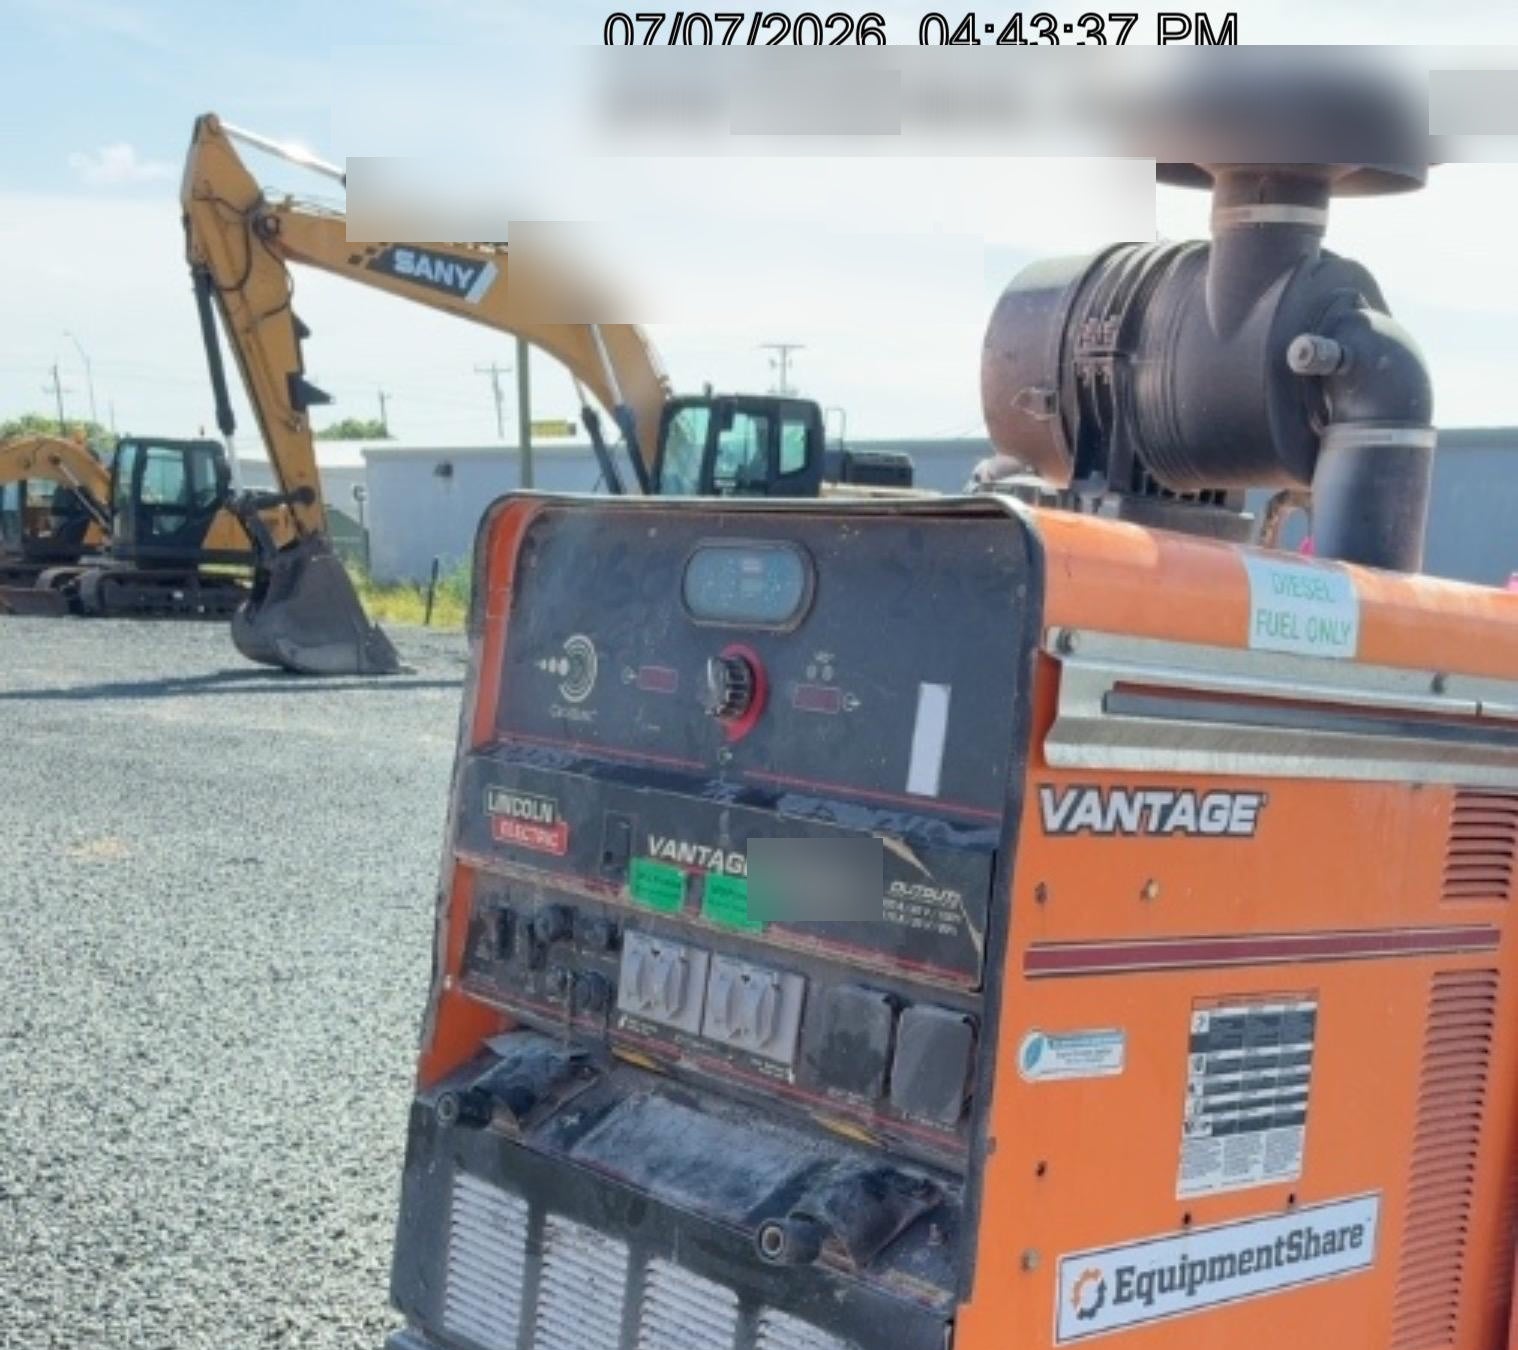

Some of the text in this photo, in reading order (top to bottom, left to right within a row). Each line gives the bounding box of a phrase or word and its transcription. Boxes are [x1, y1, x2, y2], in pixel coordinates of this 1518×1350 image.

[393, 248, 474, 289] SANY
[1272, 571, 1336, 604] DIESEL
[1256, 607, 1351, 646] FUEL ONLY
[487, 790, 554, 824] LINCOLN
[1038, 784, 1262, 837] VANTAGE
[499, 821, 560, 850] ELECTRIC
[647, 833, 748, 876] VANTAG
[1112, 1222, 1365, 1307] EquipmentShare
